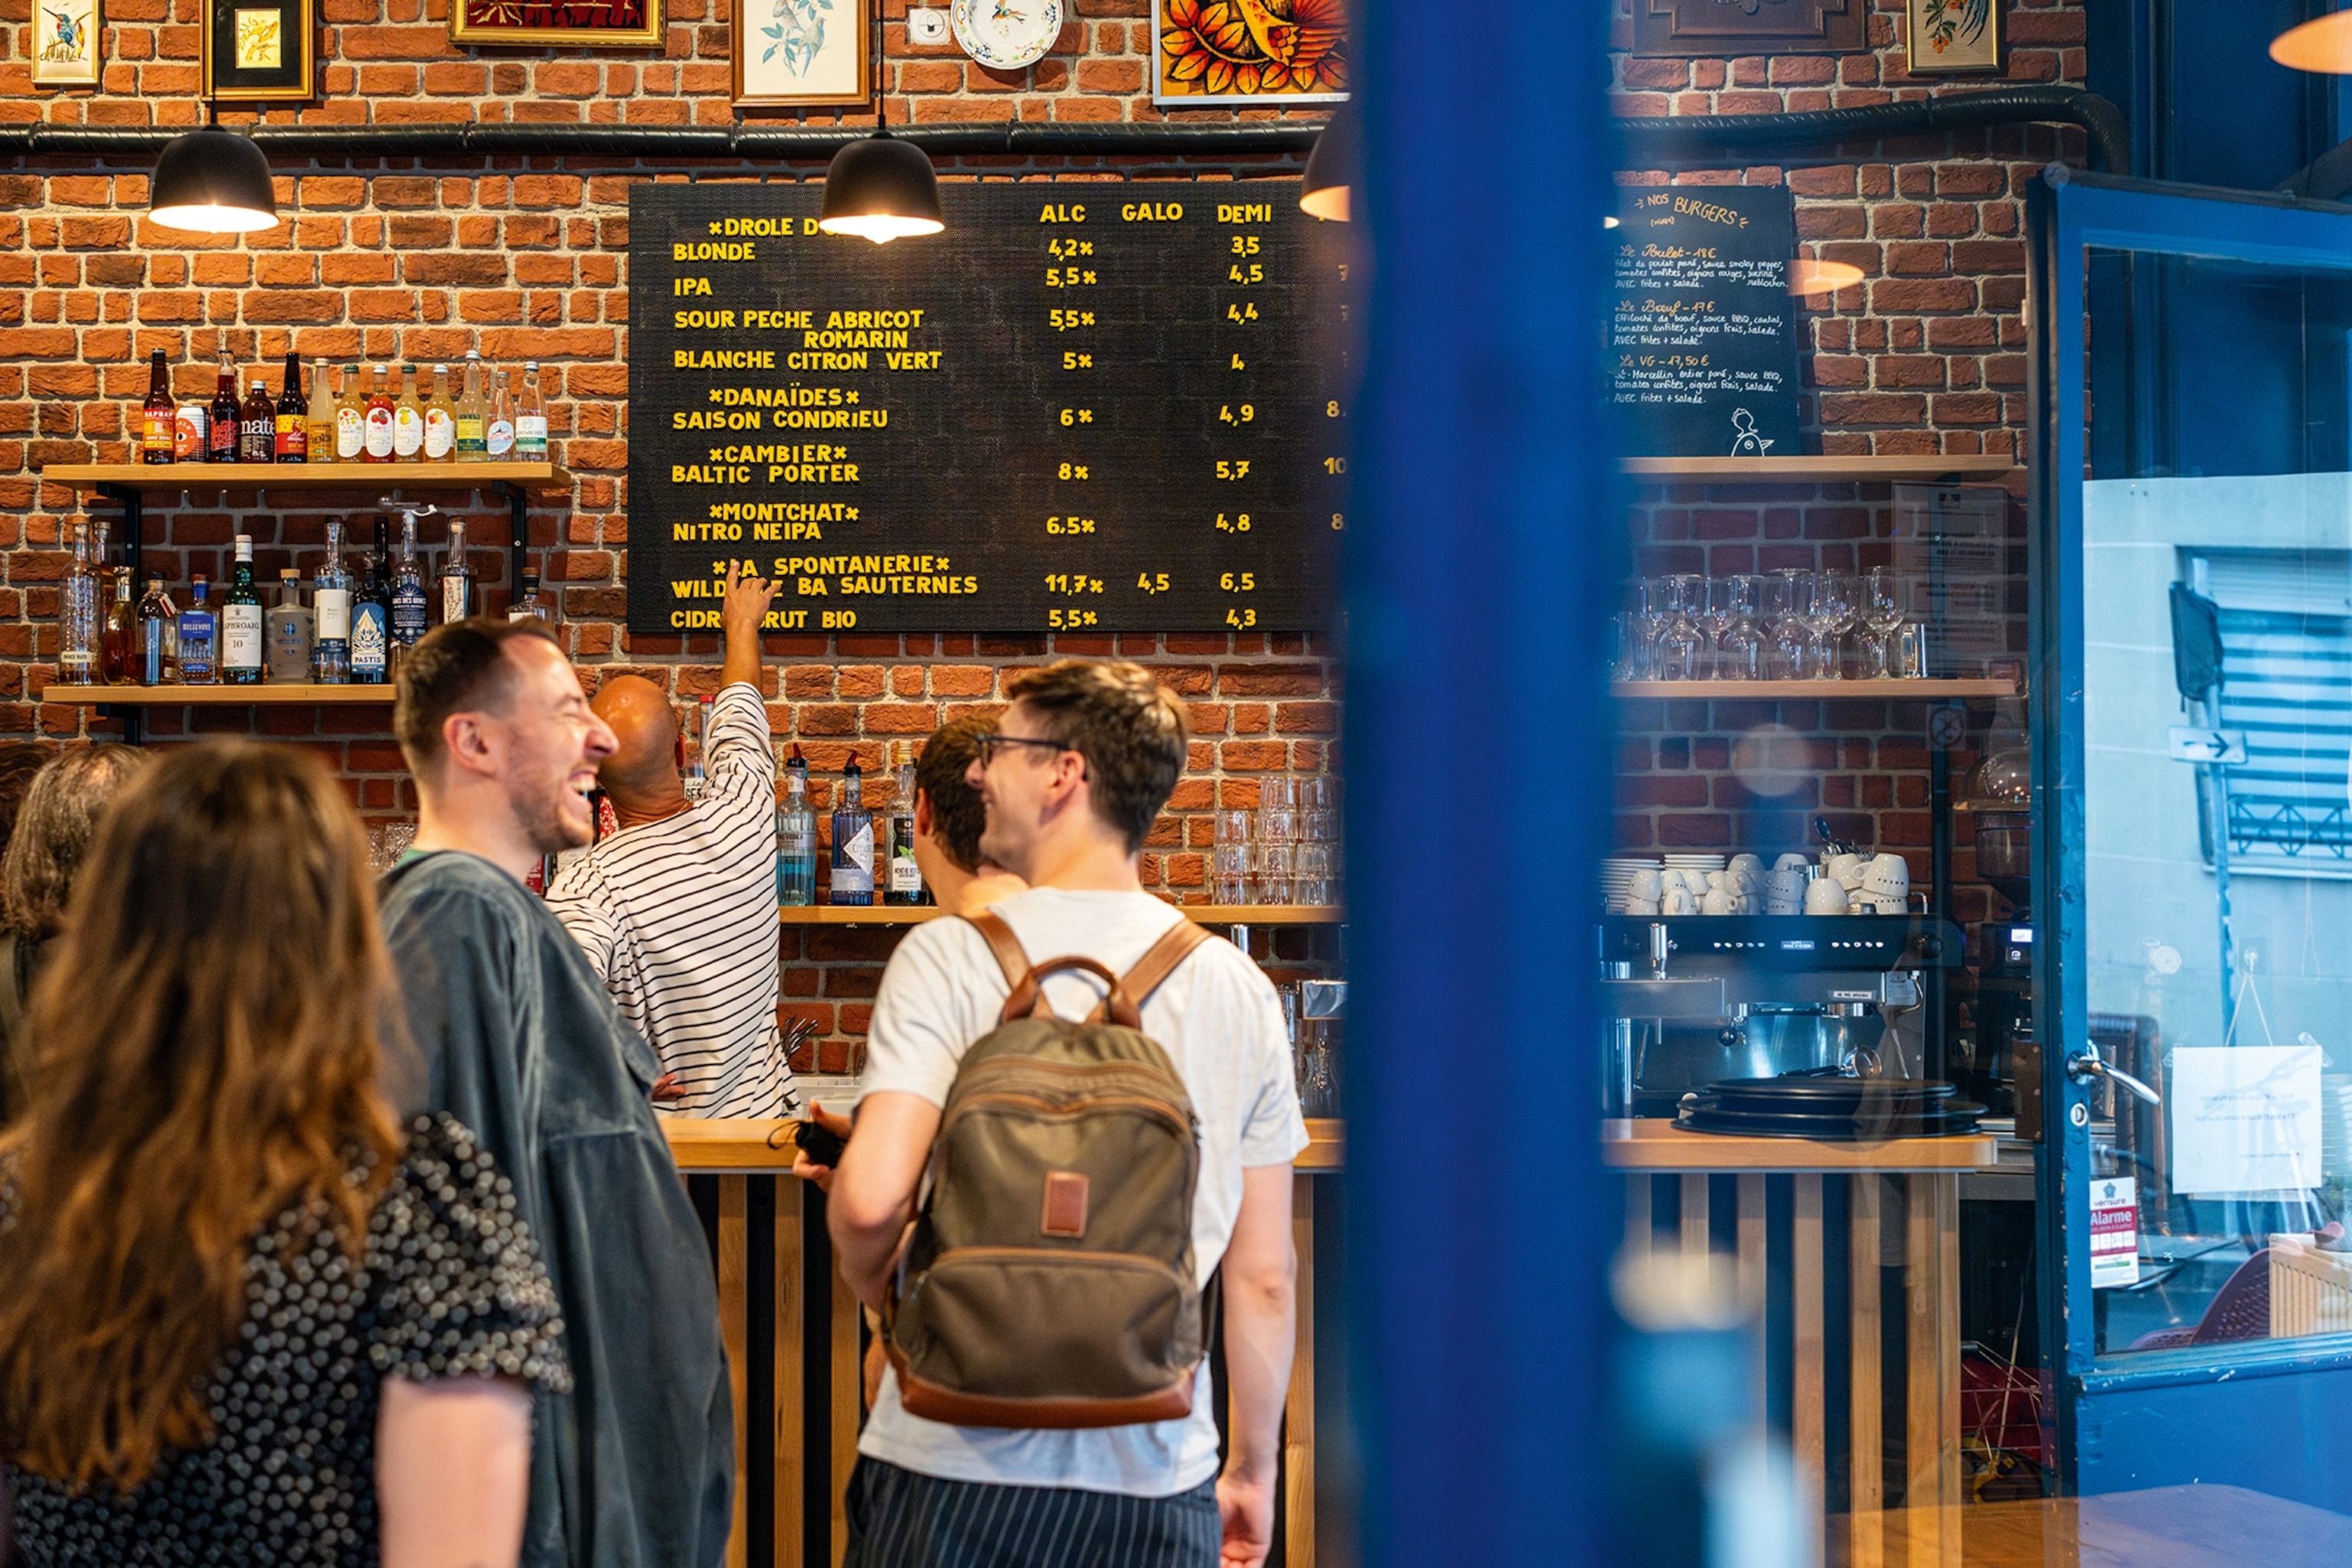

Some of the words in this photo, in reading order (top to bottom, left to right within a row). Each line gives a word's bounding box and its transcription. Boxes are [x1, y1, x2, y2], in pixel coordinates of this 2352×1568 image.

[1040, 204, 1086, 223] ALC
[1122, 203, 1183, 221] GALO
[1217, 204, 1272, 224] DEMI
[1648, 194, 1670, 206] NOS
[1674, 196, 1738, 225] BURGERS
[673, 242, 756, 261] BLONDE
[1642, 243, 1684, 259] Poulet
[1229, 264, 1263, 285] 4,5
[1648, 260, 1674, 270] poulet
[1702, 260, 1726, 269] sauce
[1615, 279, 1636, 289] AVEC
[1641, 279, 1661, 288] frites
[1687, 270, 1715, 282] oignons
[674, 277, 713, 296] IPA
[675, 311, 735, 329] SOUR
[743, 310, 812, 329] PECHE
[826, 309, 924, 329] ABRICOT
[1227, 302, 1259, 325] 4,4
[804, 330, 908, 349] ROMARIN
[1614, 335, 1637, 345] AVEC
[1641, 335, 1661, 345] frites
[1615, 323, 1648, 333] tomates
[1690, 325, 1720, 338] oignons
[674, 350, 776, 370] BLANCHE
[787, 351, 867, 371] CITRON
[885, 351, 942, 370] VERT
[1231, 353, 1245, 371] 4
[1639, 354, 1655, 367] VG
[1735, 371, 1759, 380] sauce
[1615, 379, 1650, 389] tomates
[1689, 380, 1717, 394] oignons
[1613, 393, 1637, 403] AVEC
[1641, 392, 1663, 403] frites
[672, 411, 761, 430] SAISON
[773, 409, 887, 429] CONDRIEU
[1219, 404, 1255, 427] 4,9
[671, 465, 750, 484] BALTIC
[769, 464, 859, 483] PORTER
[1216, 461, 1250, 482] 5,7
[673, 523, 743, 541] NITRO
[753, 521, 822, 541] NEIPA
[1216, 513, 1251, 534] 4,8
[671, 580, 727, 599] WILD
[798, 577, 828, 596] BA
[840, 576, 978, 595] SAUTERNES
[1137, 573, 1170, 595] 4,5
[1220, 572, 1256, 593] 6,5
[671, 610, 723, 629] CIDR
[822, 610, 857, 629] BIO
[1226, 609, 1256, 630] 4,3
[232, 639, 243, 648] 10
[2093, 1197, 2126, 1207] verisure
[2091, 1210, 2132, 1226] Alarme
